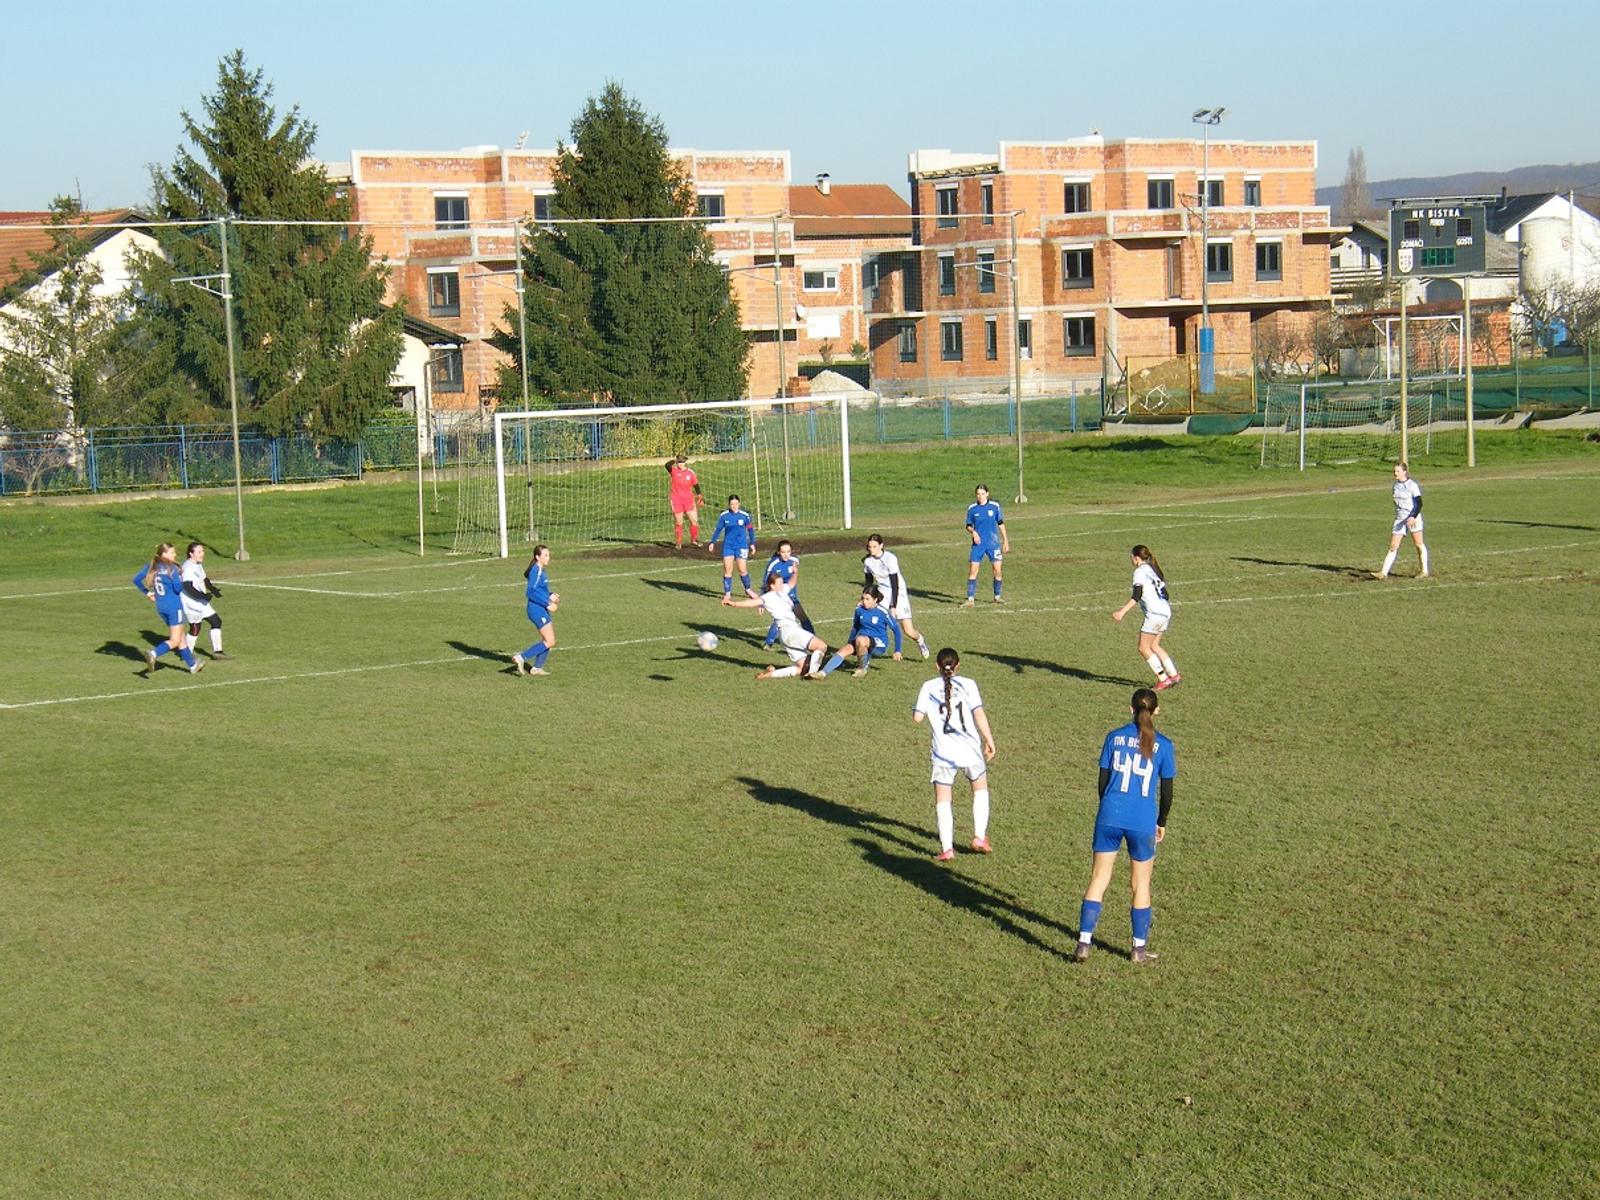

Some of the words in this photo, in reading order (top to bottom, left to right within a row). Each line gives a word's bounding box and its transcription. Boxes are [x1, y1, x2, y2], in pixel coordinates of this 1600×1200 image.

[1412, 209, 1424, 218] NK
[1428, 208, 1460, 218] BISTRA
[1456, 237, 1473, 246] GOSTI
[1113, 751, 1153, 797] 44
